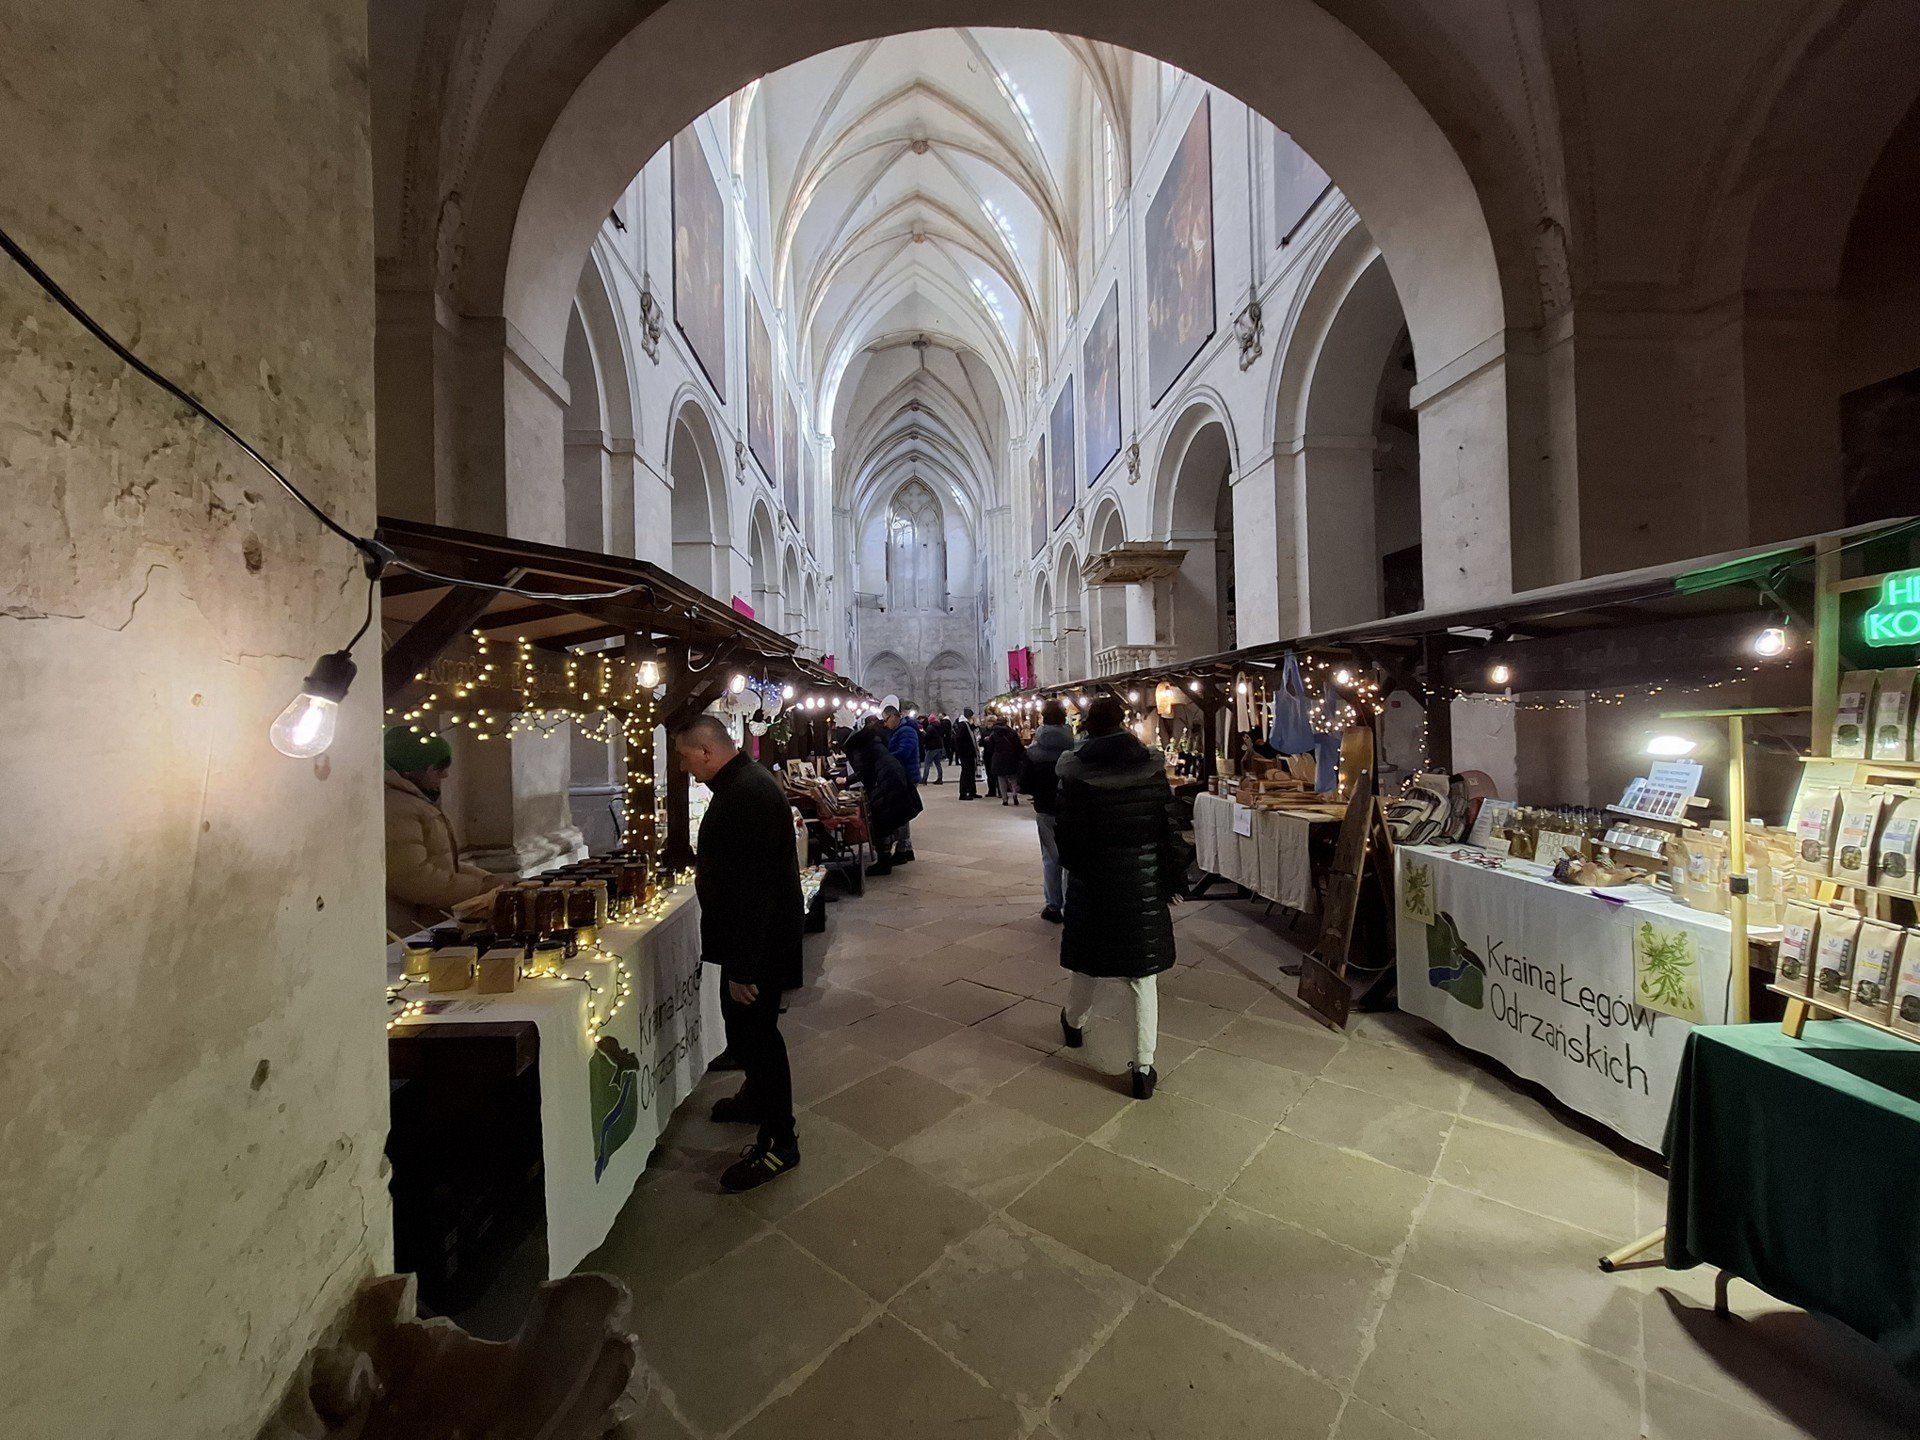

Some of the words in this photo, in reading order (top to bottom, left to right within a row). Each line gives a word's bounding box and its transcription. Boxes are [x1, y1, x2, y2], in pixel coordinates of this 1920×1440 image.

[1486, 935, 1556, 997] Kraina
[1560, 963, 1656, 1038] Łęgów
[1490, 983, 1649, 1096] Odrzańskich
